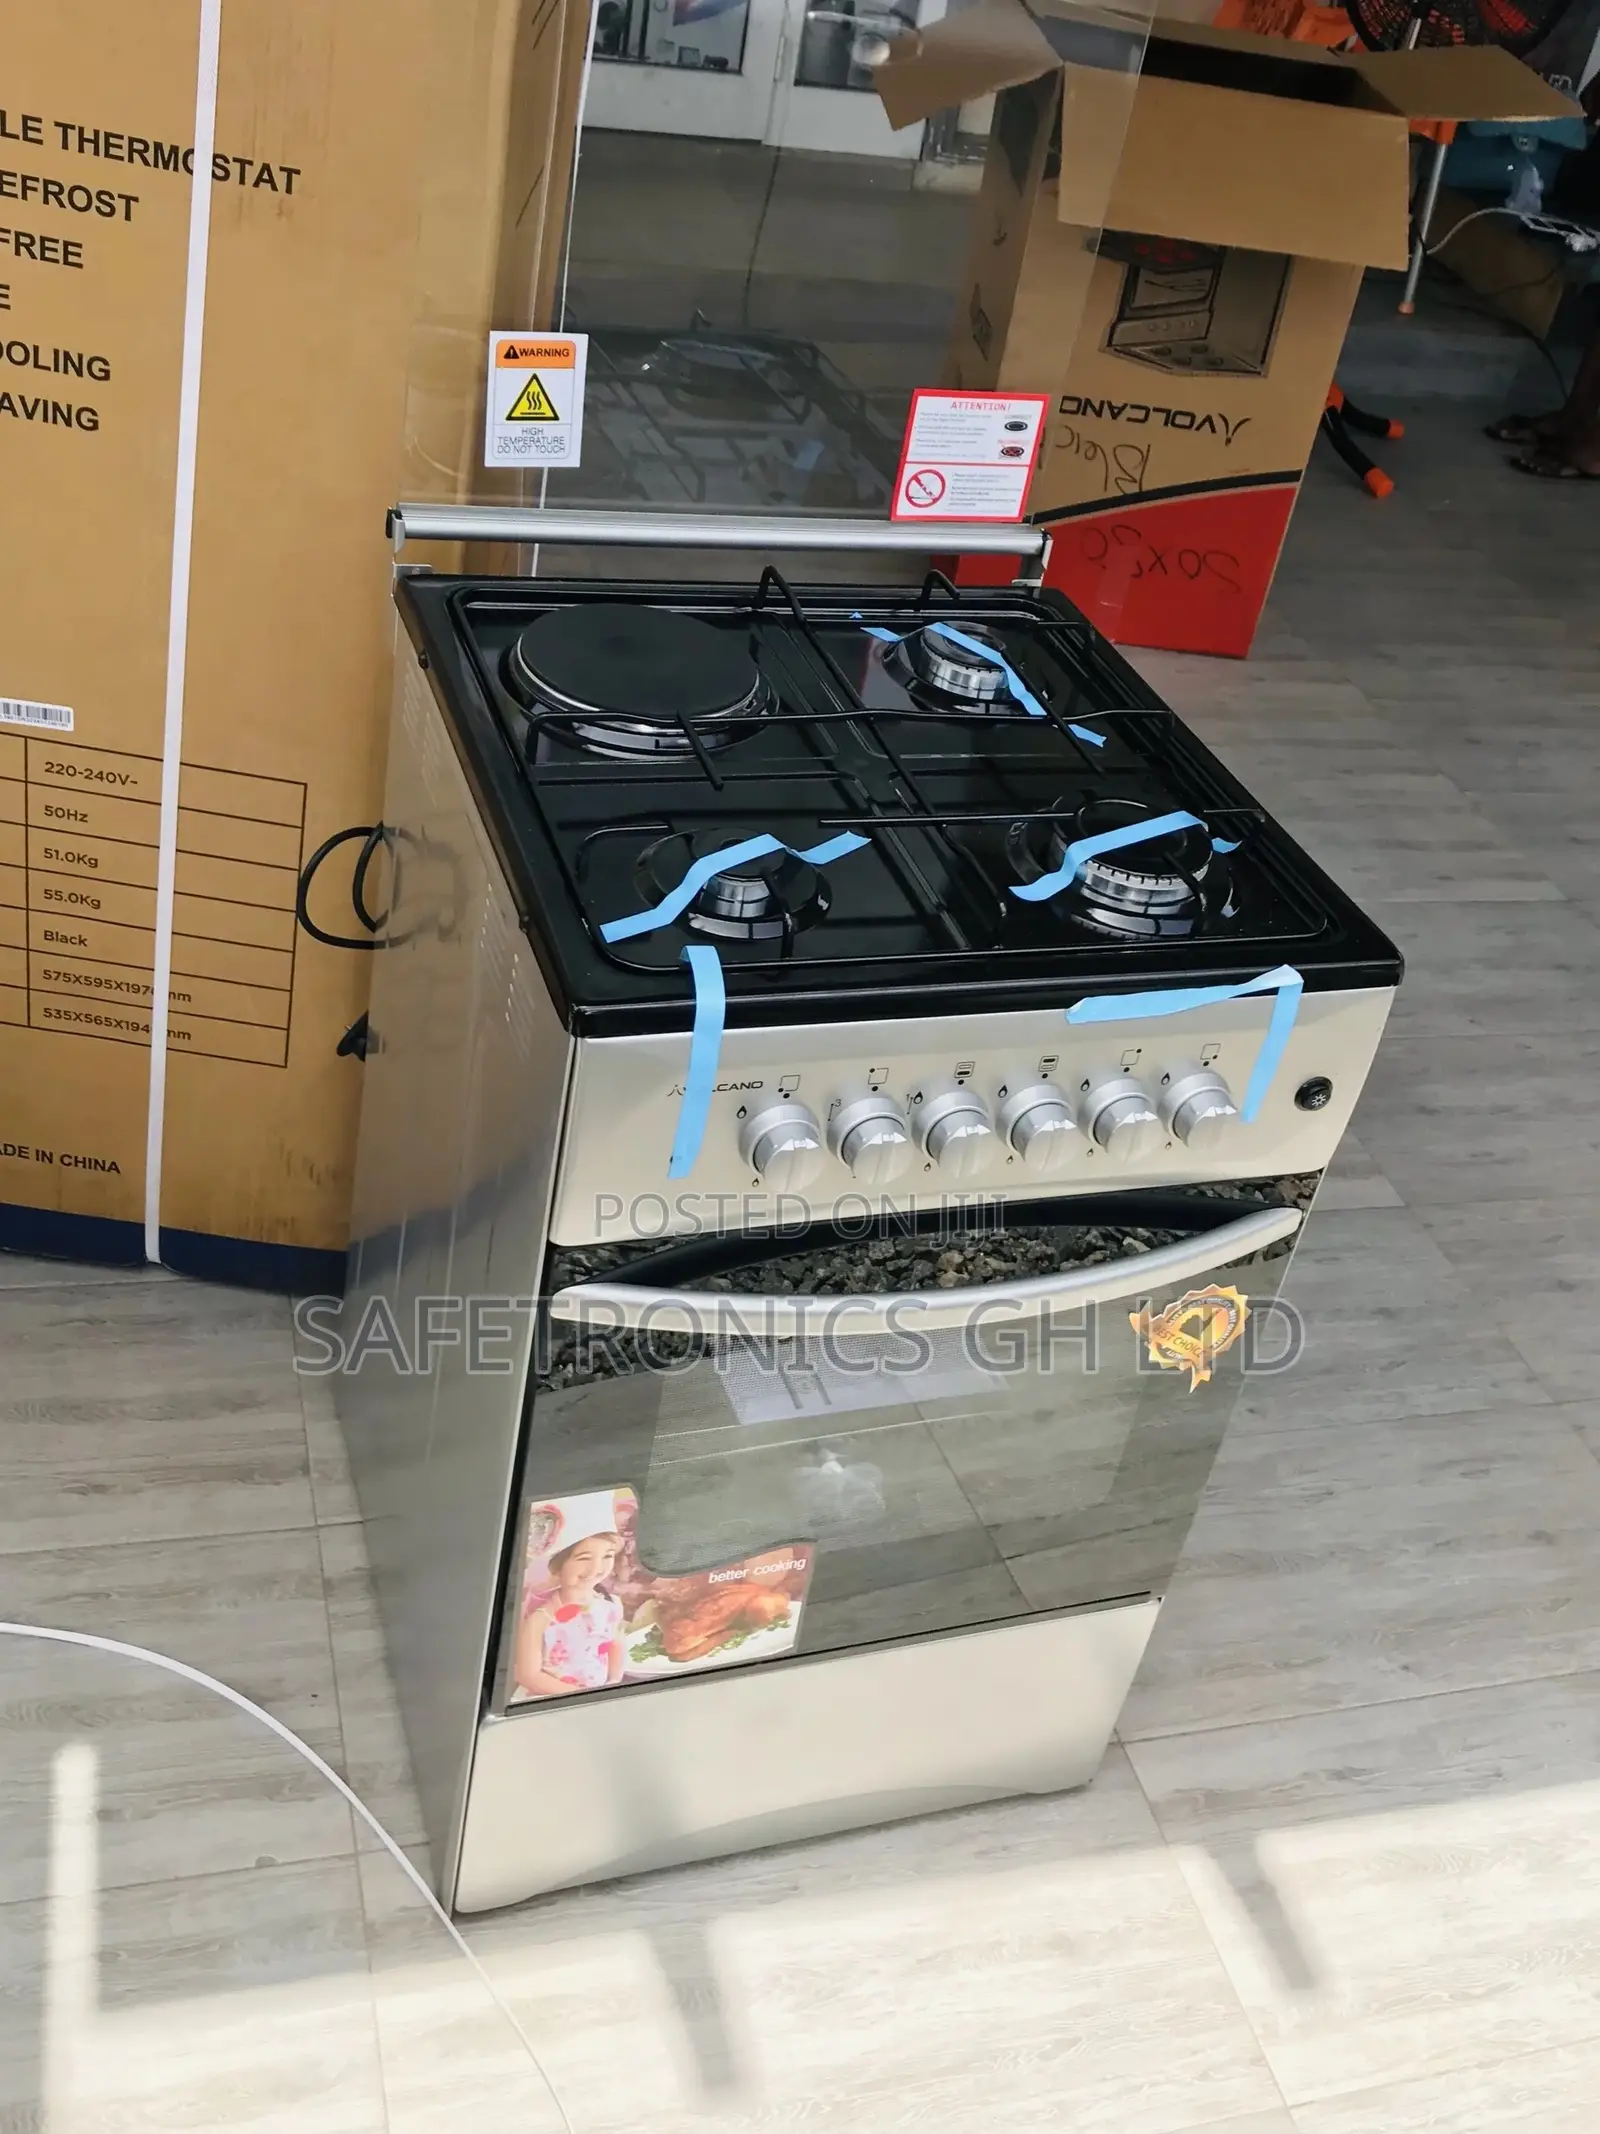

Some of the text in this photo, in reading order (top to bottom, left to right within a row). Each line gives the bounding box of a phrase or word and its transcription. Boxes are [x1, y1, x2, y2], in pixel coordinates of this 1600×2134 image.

[0, 168, 139, 221] EFROST
[0, 340, 111, 381] OLING
[519, 348, 570, 358] WARNING
[0, 392, 99, 431] AVING
[950, 401, 1012, 412] ATTENTION!
[1059, 395, 1216, 433] VOLCANO
[497, 445, 566, 453] DO NOT TOUCH
[498, 436, 564, 445] TEMPERATURE
[44, 805, 89, 824] 50Hz
[44, 847, 99, 869] 51.0Kg
[43, 888, 101, 910] 55.0Kg
[43, 929, 88, 948] Black
[42, 969, 192, 1003] 575X595X197mm
[43, 1007, 192, 1040] 535X565X194mm
[834, 1099, 842, 1107] 3
[0, 1143, 121, 1174] DE IN CHINA
[1173, 1337, 1206, 1358] CHOICE
[708, 1558, 807, 1584] better cooking
